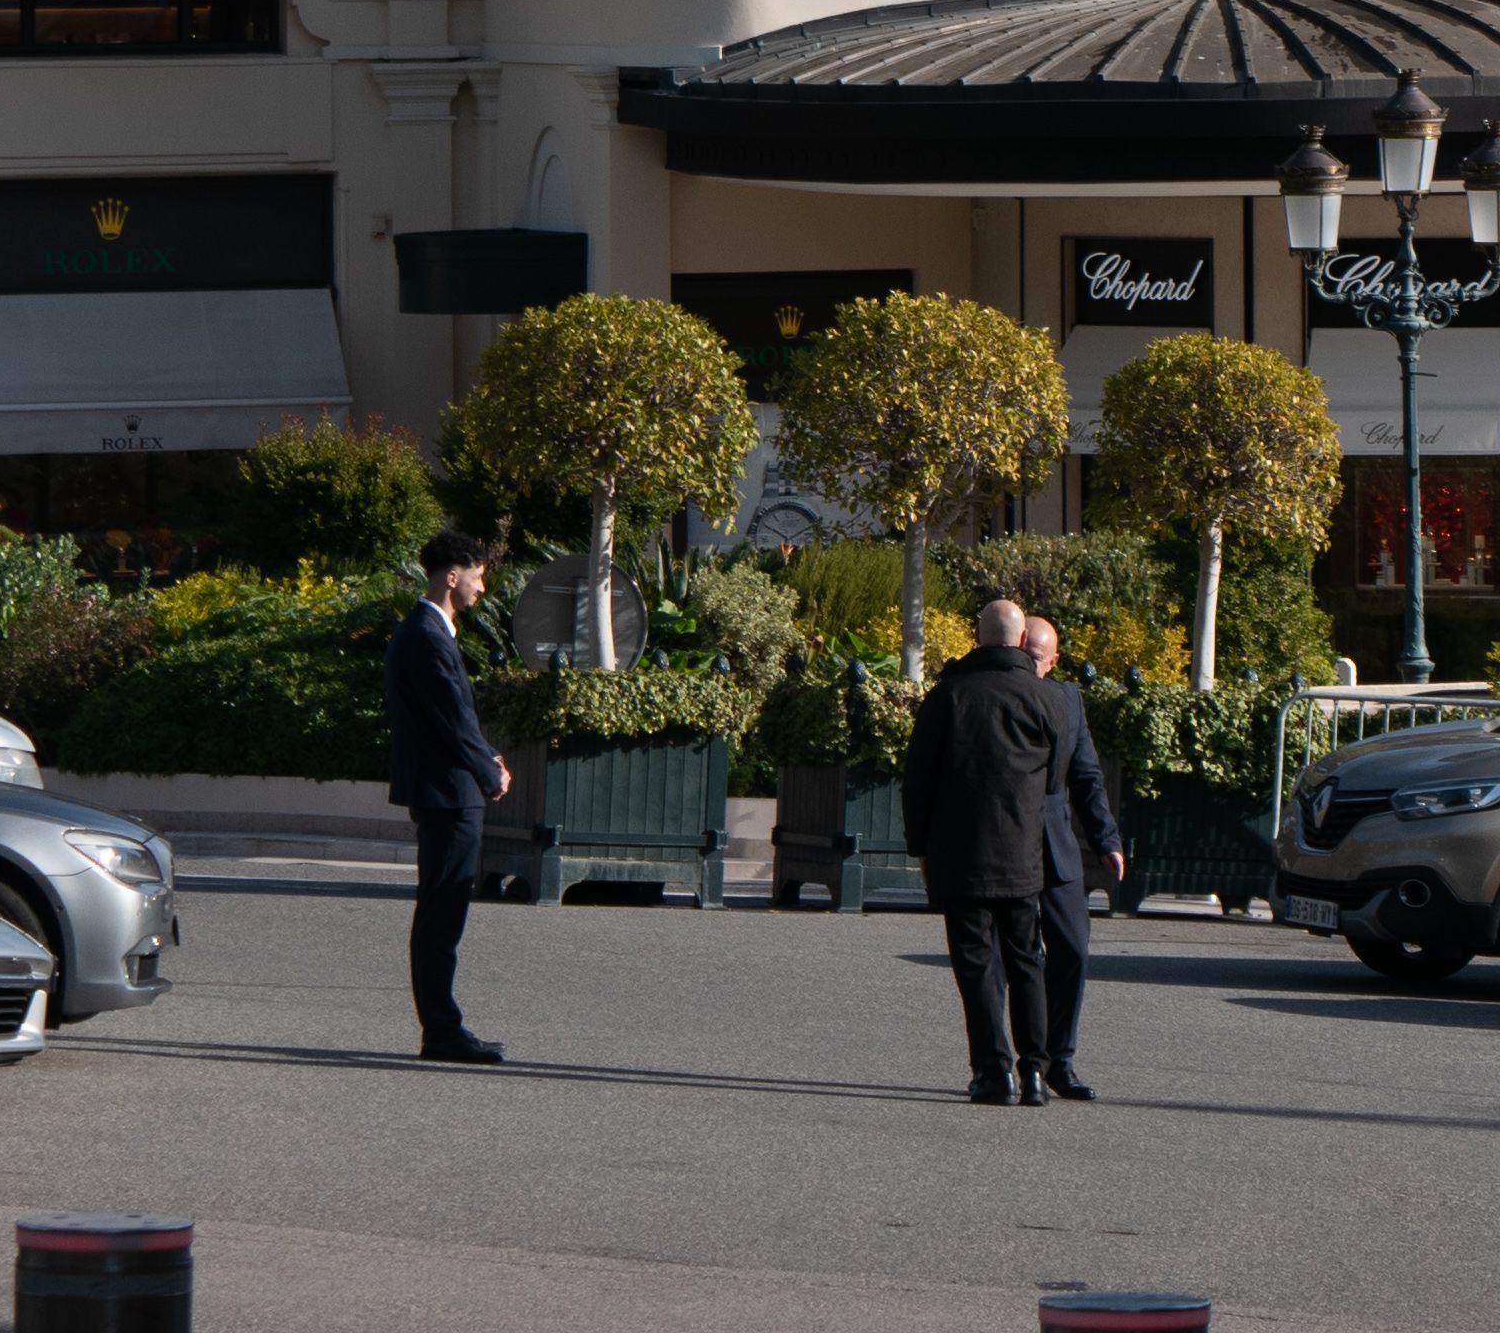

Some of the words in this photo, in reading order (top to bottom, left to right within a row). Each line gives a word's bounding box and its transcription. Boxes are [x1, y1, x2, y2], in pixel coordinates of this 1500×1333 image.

[44, 247, 178, 275] ROLEX
[1082, 252, 1204, 311] Chopard
[102, 436, 165, 451] ROLEX
